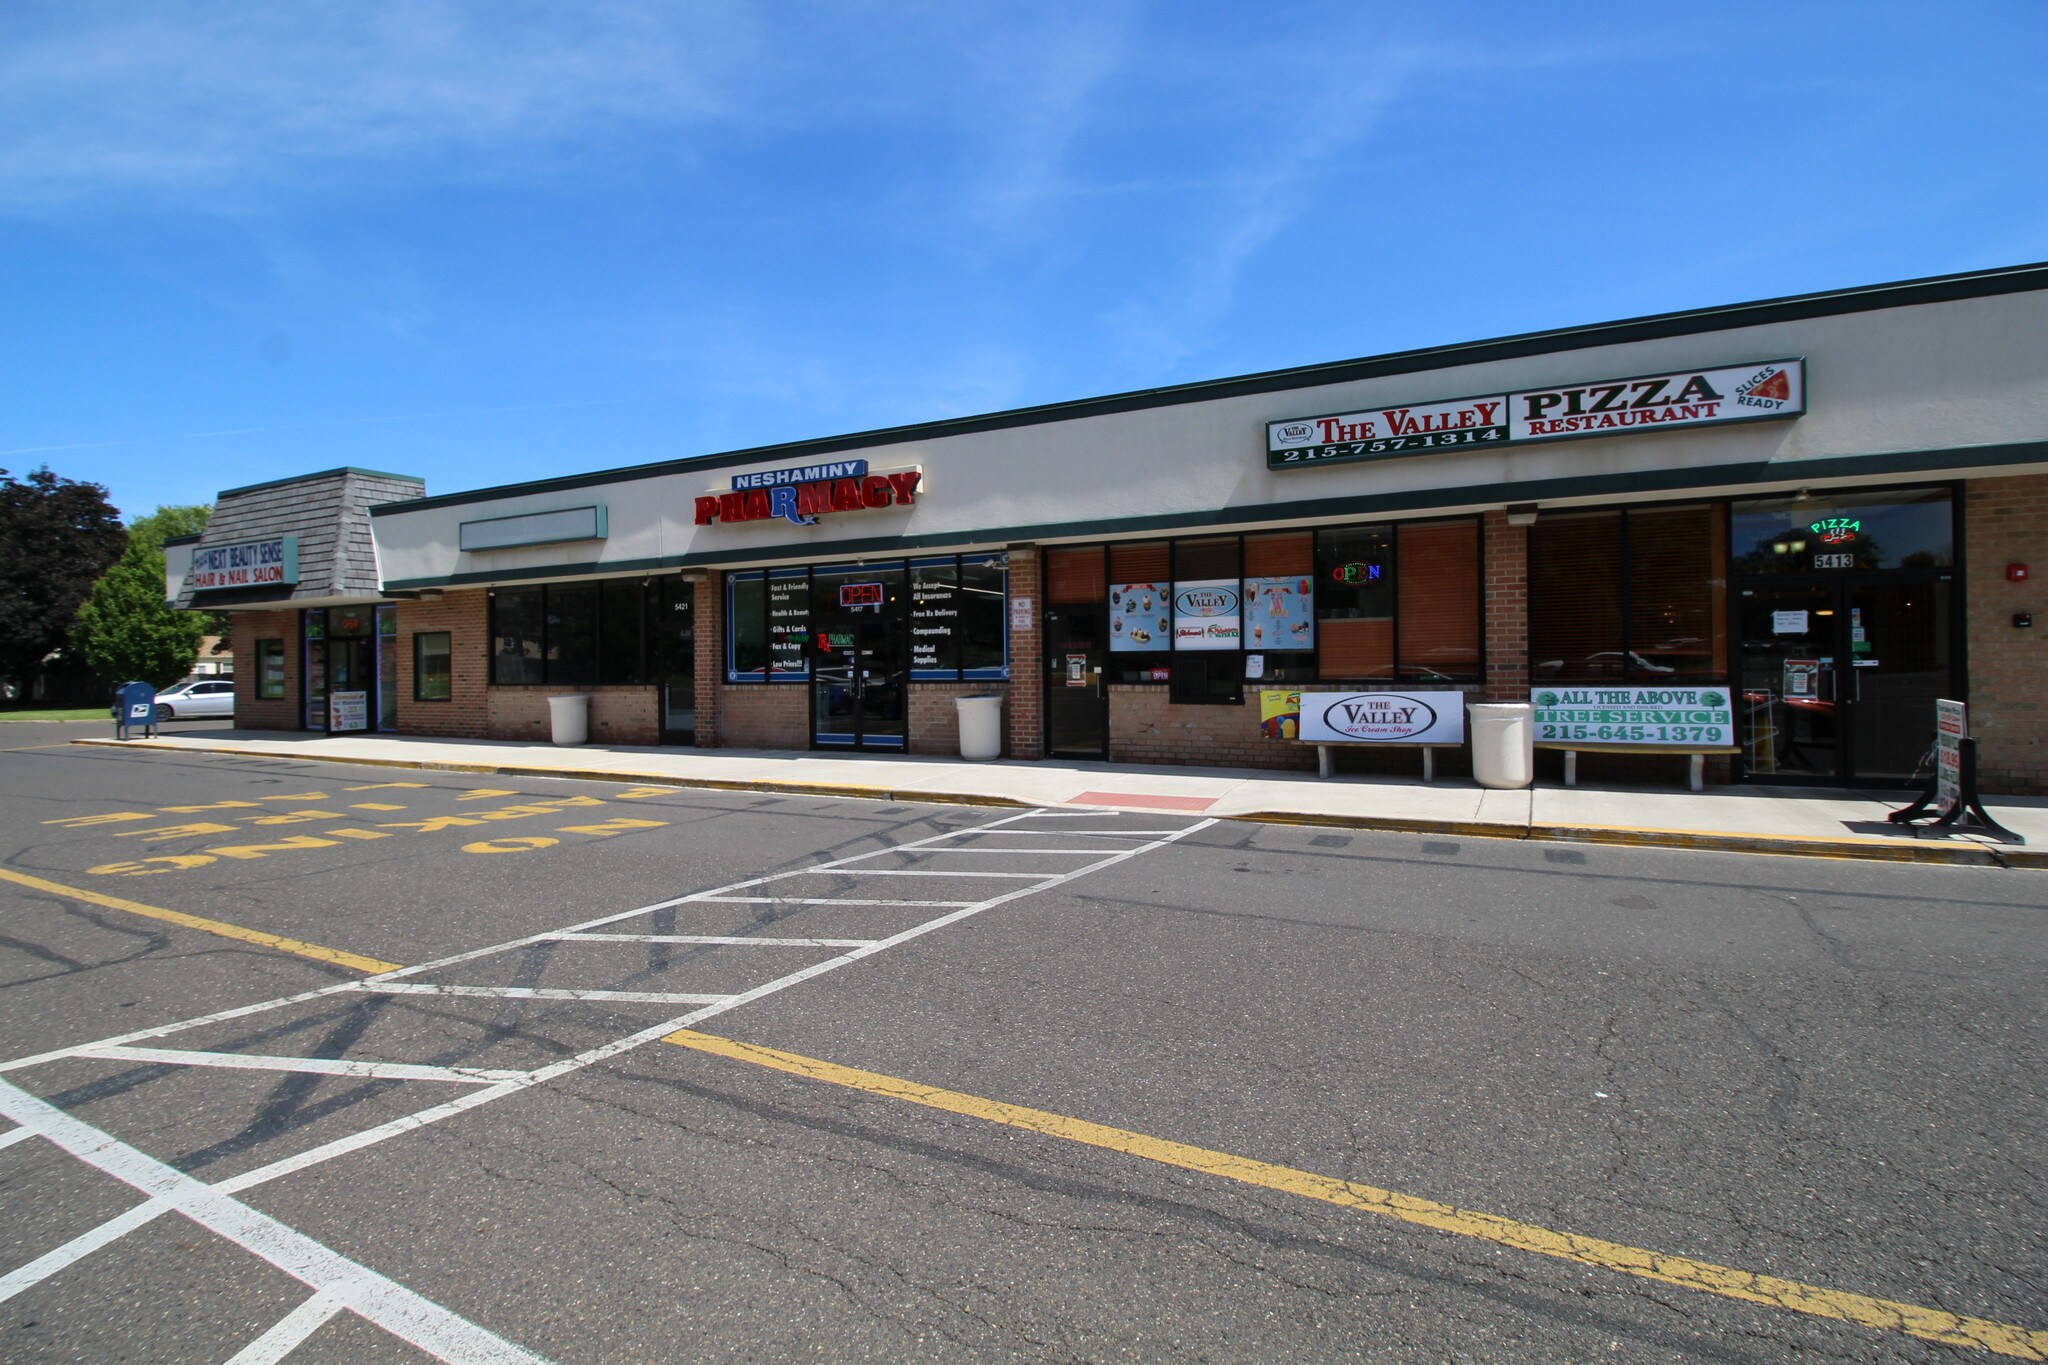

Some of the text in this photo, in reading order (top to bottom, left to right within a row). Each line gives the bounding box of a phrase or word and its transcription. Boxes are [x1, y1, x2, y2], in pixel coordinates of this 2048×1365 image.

[1735, 366, 1775, 396] SLICES
[1523, 375, 1724, 420] PIZZA
[1736, 396, 1784, 411] READY
[1528, 402, 1720, 435] RESTAURANT
[1284, 429, 1500, 462] 215-757-1314
[736, 462, 858, 489] NESHAMINY
[694, 471, 921, 526] PHARMACY
[1810, 518, 1860, 533] PIZZA
[208, 549, 227, 570] NEXT
[230, 544, 258, 568] BEAUTY
[260, 541, 282, 564] SENSE
[1816, 554, 1852, 568] 5413
[195, 566, 283, 587] HAIR & NAIL SALON
[1332, 565, 1380, 580] OPEN
[771, 584, 782, 592] Fast
[788, 582, 809, 591] Friendly
[913, 582, 940, 590] We Accept
[842, 585, 882, 605] OPEN
[922, 592, 952, 600] Insurances
[913, 626, 951, 636] Compounding
[828, 634, 854, 645] PHARMAC
[914, 645, 935, 653] Medical
[914, 655, 937, 664] Supplies
[1560, 691, 1698, 705] ALL THE ABOVE
[1368, 702, 1391, 710] THE
[1341, 704, 1418, 724] VALLEY
[1538, 710, 1725, 723] TREE SERVICE
[1345, 725, 1412, 734] Ice Cream Shop
[1542, 724, 1722, 742] 215-645-1379
